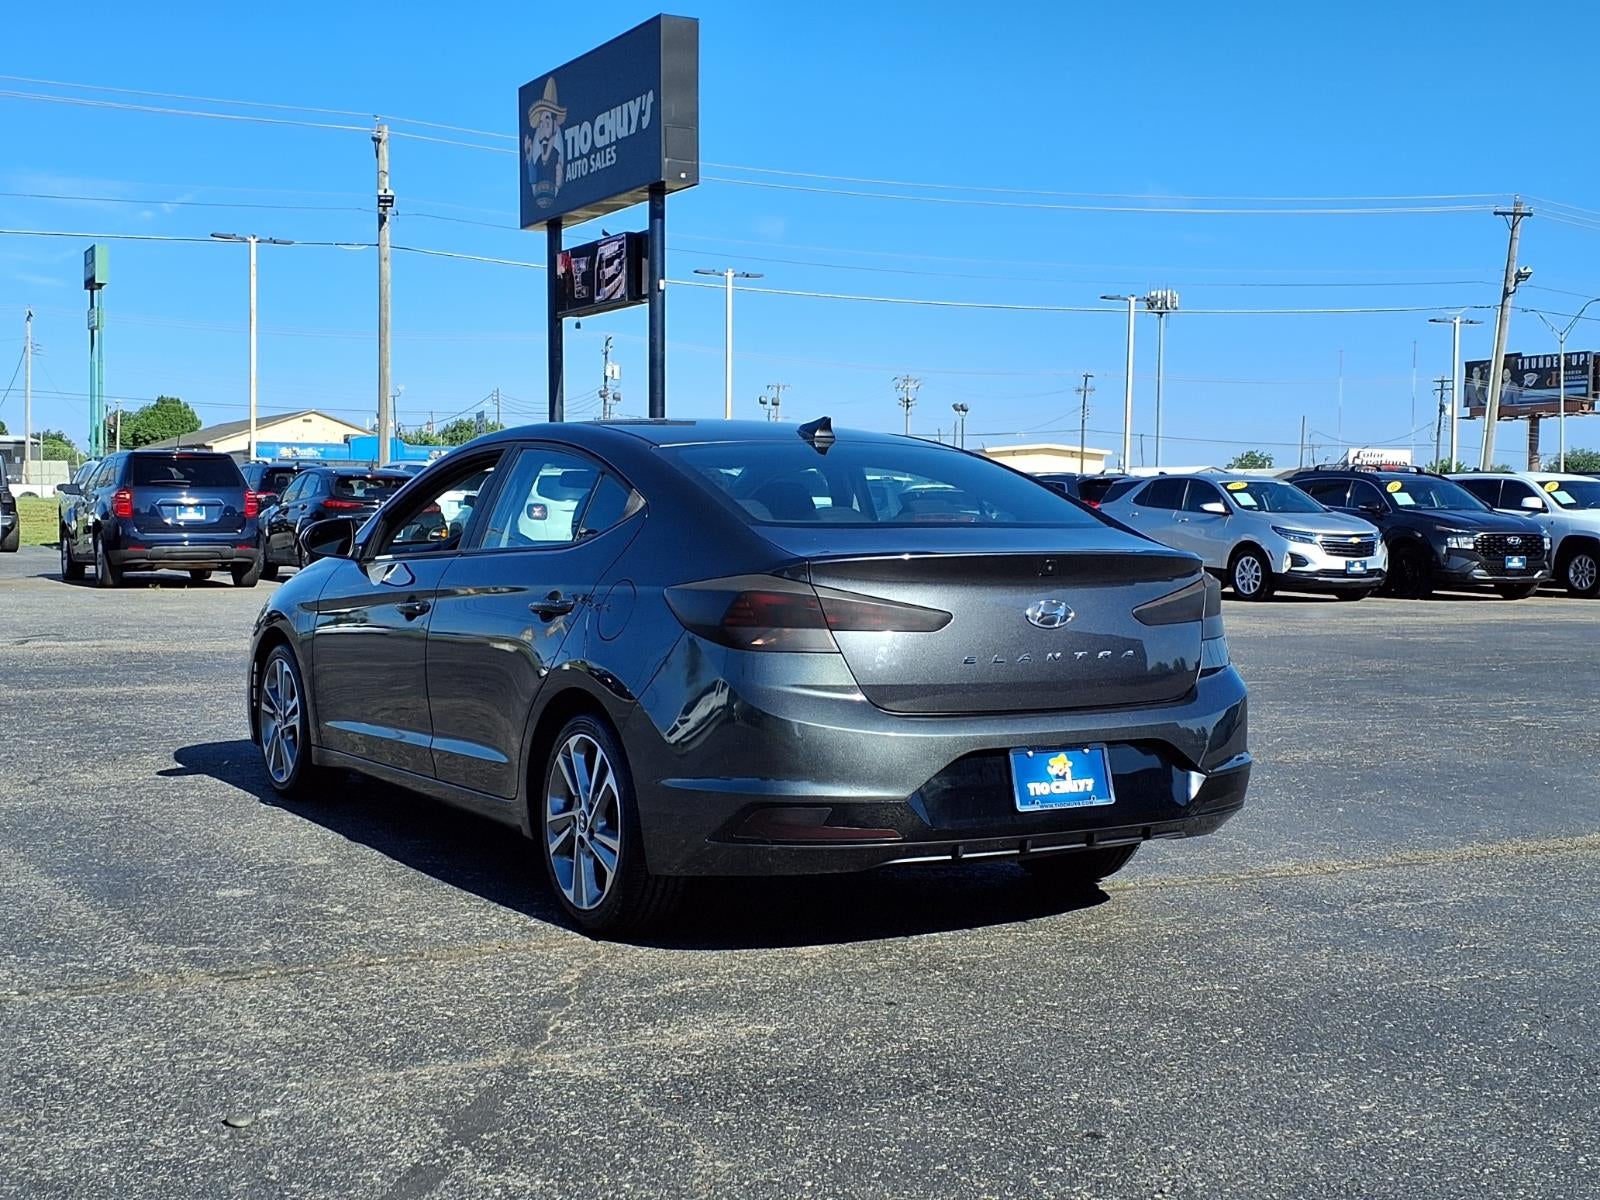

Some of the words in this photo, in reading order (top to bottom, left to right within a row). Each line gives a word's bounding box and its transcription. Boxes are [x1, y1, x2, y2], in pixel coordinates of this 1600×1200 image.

[564, 120, 592, 161] TIO
[593, 88, 655, 149] CHUY'S
[565, 157, 588, 183] AUTO
[589, 145, 617, 174] SALES
[1517, 355, 1564, 370] THUNDE
[1571, 353, 1590, 366] UP!
[963, 650, 1136, 665] ELANTRA
[1027, 781, 1050, 796] TIO
